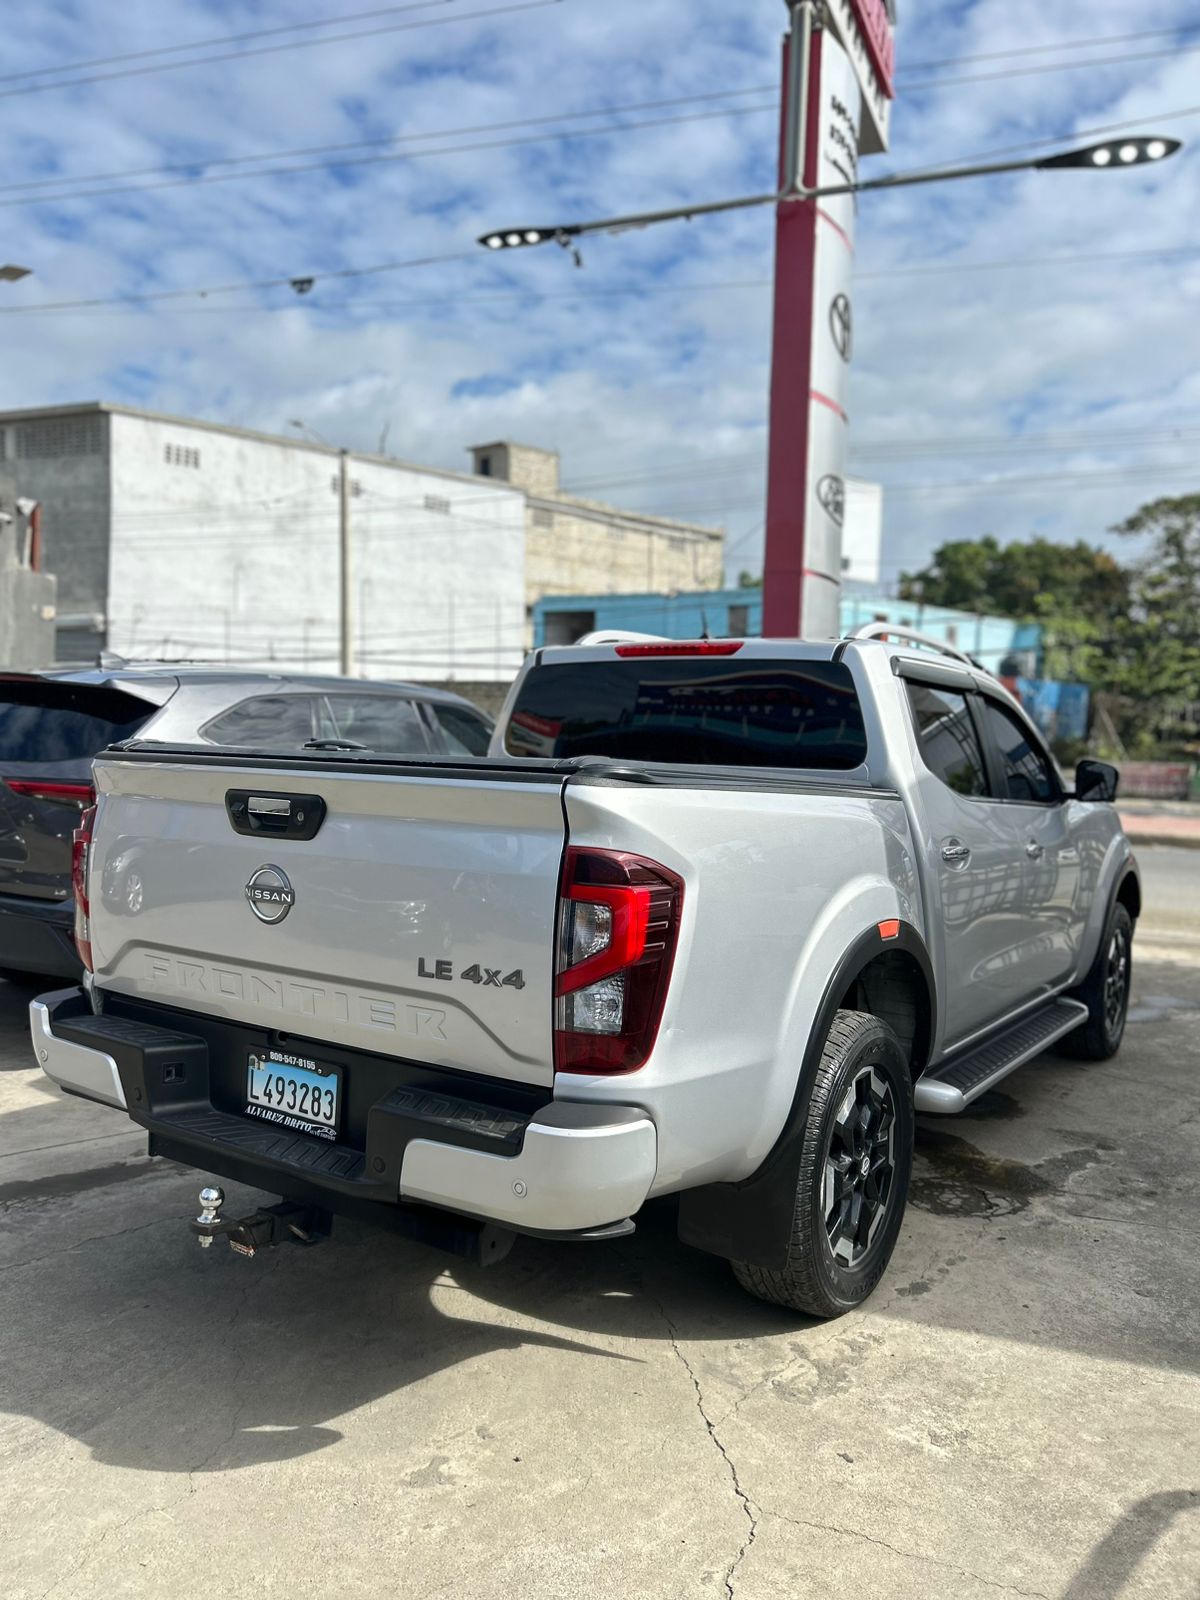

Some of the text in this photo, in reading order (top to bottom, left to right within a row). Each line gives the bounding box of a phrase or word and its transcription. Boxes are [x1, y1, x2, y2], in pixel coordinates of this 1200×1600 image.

[245, 888, 291, 902] NISSAN
[417, 957, 453, 981] LE
[143, 952, 448, 1042] FRONTIER
[269, 1051, 316, 1070] 809-547-8155
[250, 1069, 335, 1121] L493283
[244, 1105, 313, 1132] ALVAREZ BRITO
